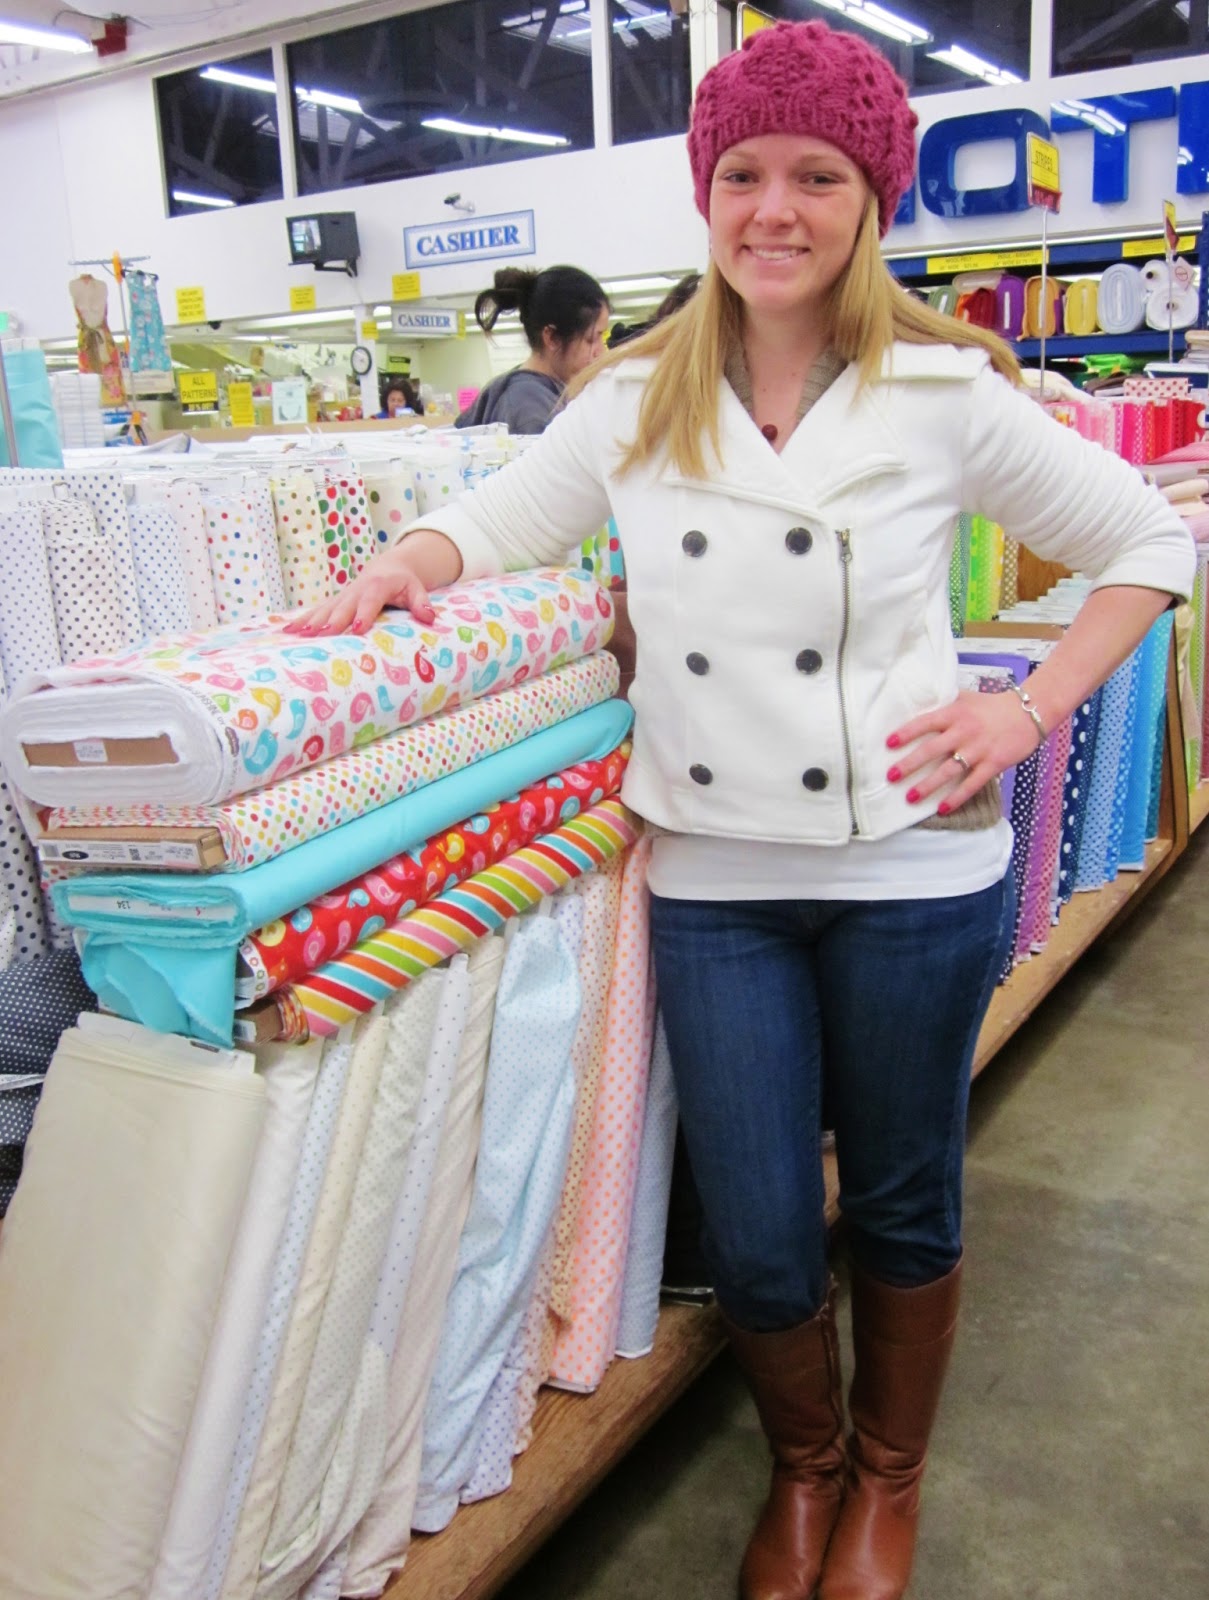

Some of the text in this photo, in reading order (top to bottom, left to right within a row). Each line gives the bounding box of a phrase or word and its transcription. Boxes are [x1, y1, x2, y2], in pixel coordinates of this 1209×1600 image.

[416, 224, 520, 256] CASHIER
[397, 313, 451, 328] CASHIER
[192, 377, 205, 386] ALL
[181, 388, 217, 400] PATTERNS
